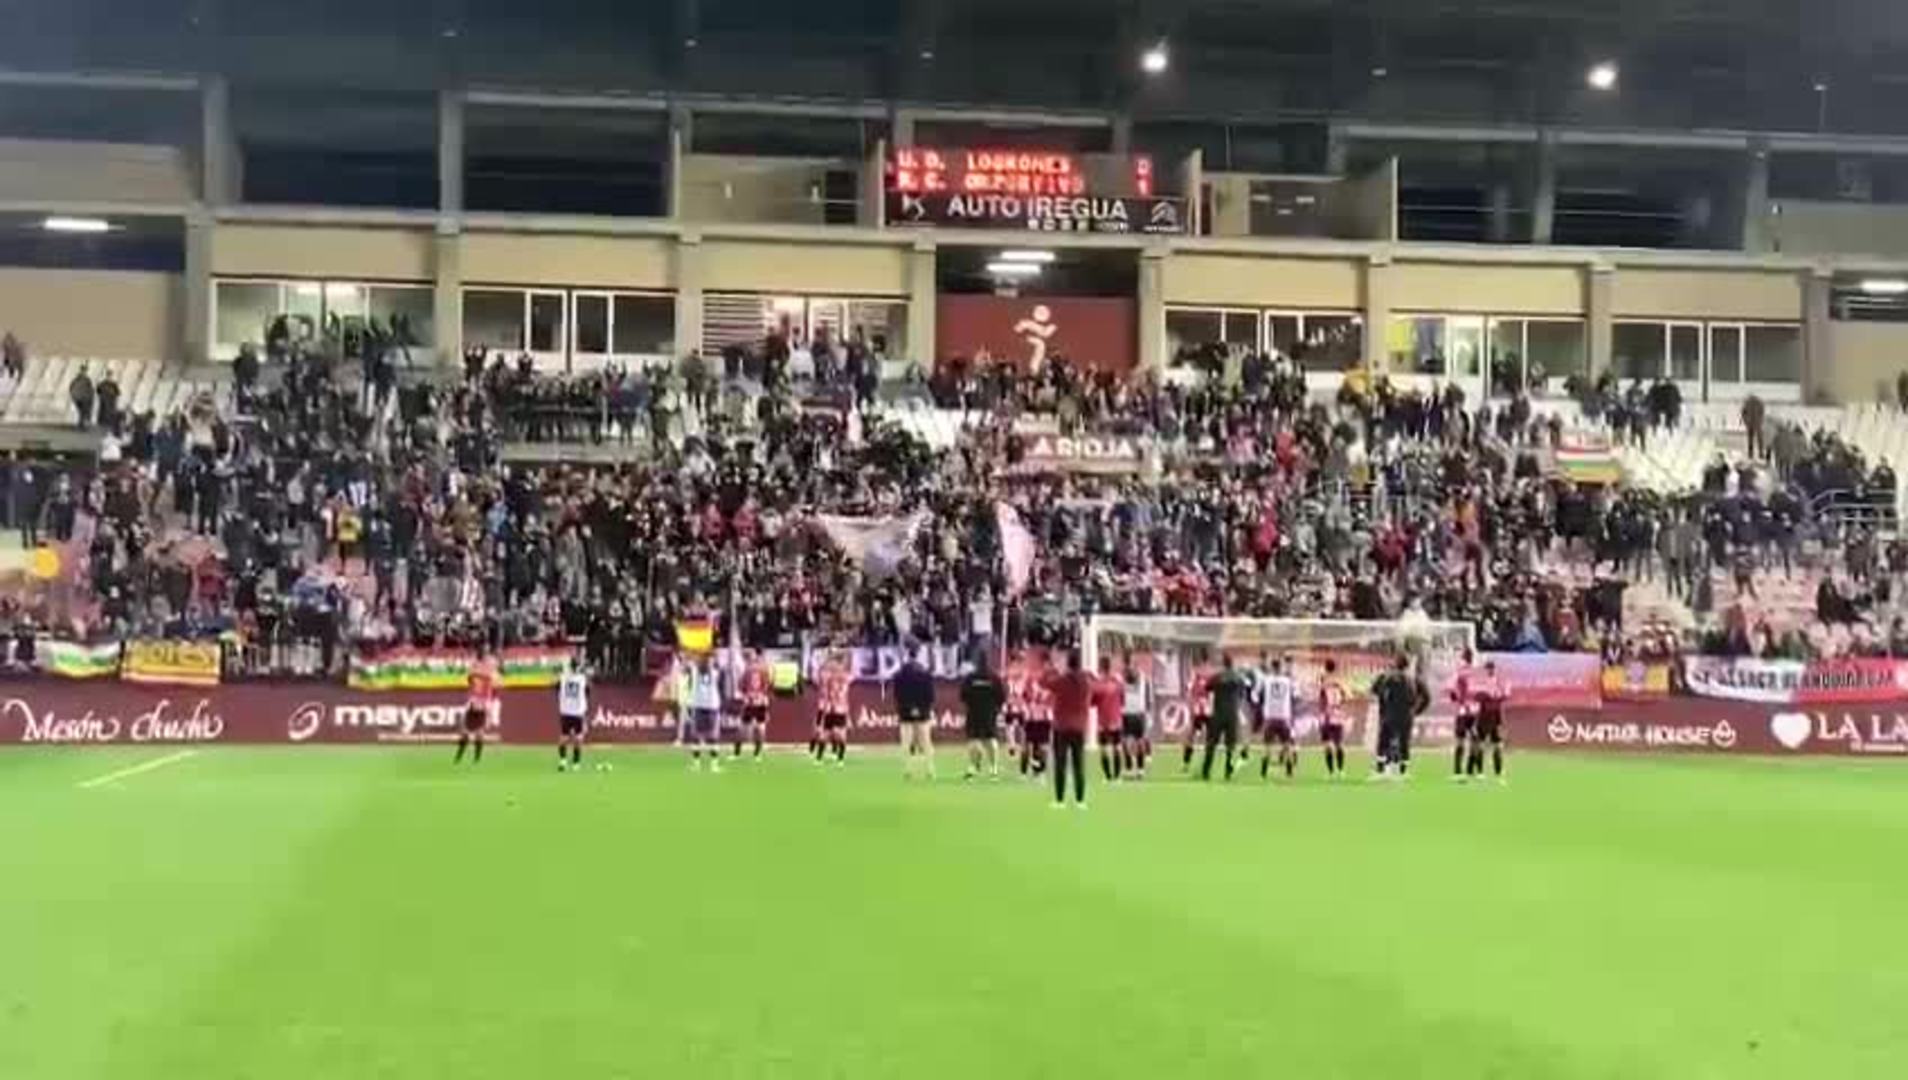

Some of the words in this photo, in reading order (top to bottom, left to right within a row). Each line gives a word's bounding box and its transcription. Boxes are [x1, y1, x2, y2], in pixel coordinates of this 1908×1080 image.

[947, 195, 1020, 218] AUTO
[1027, 196, 1127, 221] IREGUA
[1056, 438, 1133, 458] RIOJA
[333, 701, 500, 735] mayorl
[1817, 713, 1864, 743] LA
